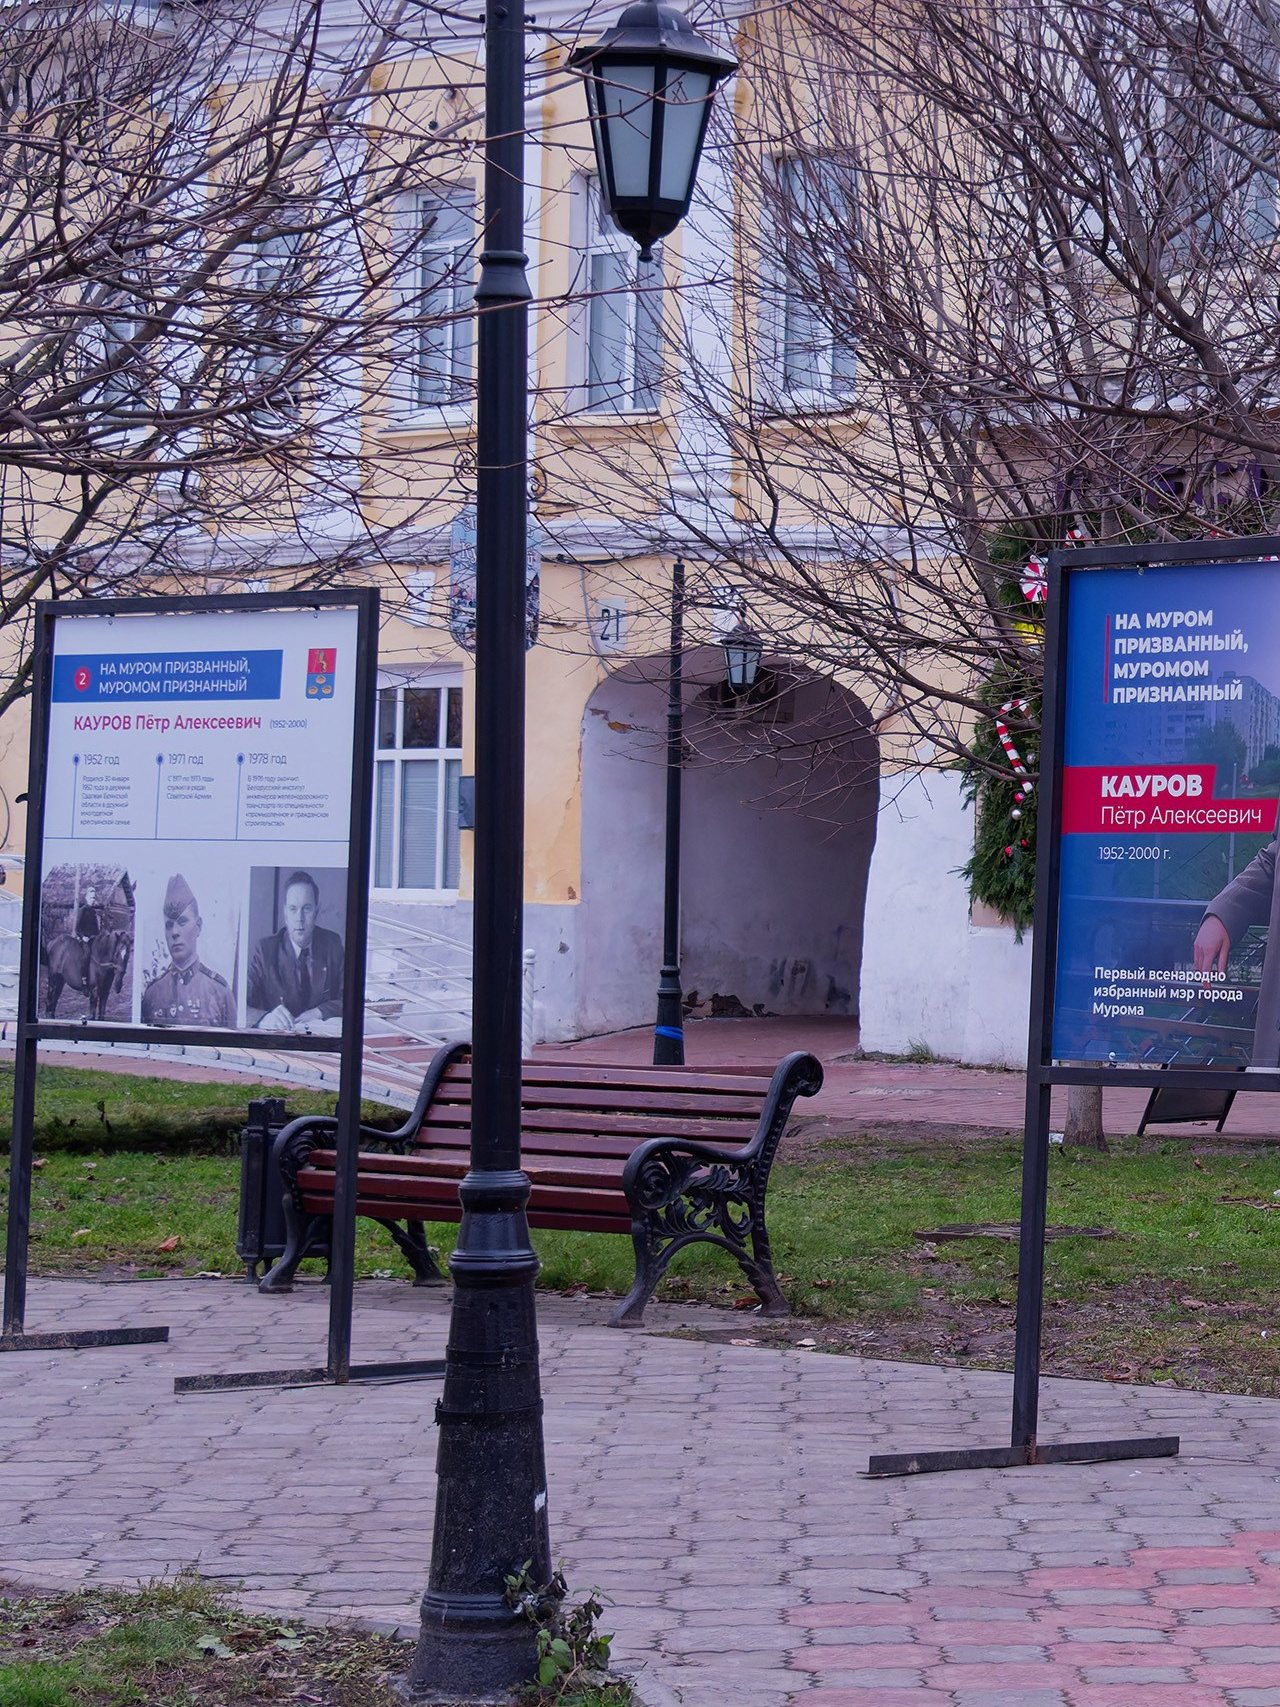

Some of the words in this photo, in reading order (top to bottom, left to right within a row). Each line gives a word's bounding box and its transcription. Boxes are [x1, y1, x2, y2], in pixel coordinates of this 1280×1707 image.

[600, 608, 619, 641] 21
[1115, 613, 1141, 630] НА
[1146, 610, 1213, 629] МУРОМ
[1114, 629, 1249, 654] ПРИЗВАННЫЙ,
[100, 663, 116, 675] НА
[119, 662, 162, 675] МУРОМ
[165, 657, 250, 674] ПРИЗВАННЫЙ,
[1113, 660, 1209, 679] МУРОМОМ
[79, 672, 86, 685] 2
[99, 681, 160, 694] МУРОМОМ
[163, 676, 247, 693] ПРИЗНАННЫЙ
[1112, 679, 1243, 704] ПРИЗНАННЫЙ
[73, 715, 131, 731] КАУРОВ
[135, 714, 170, 733] Пётр
[173, 714, 262, 730] Алексеевич
[84, 754, 102, 764] 1952
[104, 756, 120, 766] год
[168, 754, 186, 764] 1971
[188, 756, 204, 766] год
[249, 753, 268, 764] 1978
[271, 755, 287, 765] год
[1101, 774, 1203, 797] КАУРОВ
[1101, 805, 1146, 829] Пётр
[1149, 805, 1262, 825] Алексеевич
[1098, 846, 1160, 860] 1952-2000
[1163, 849, 1171, 860] г.
[1094, 967, 1145, 982] Первый
[1149, 969, 1227, 984] всенародно
[1093, 984, 1167, 1000] избранный
[1170, 988, 1195, 1002] мэр
[1198, 988, 1243, 1003] города
[1092, 1002, 1145, 1018] Мурома
